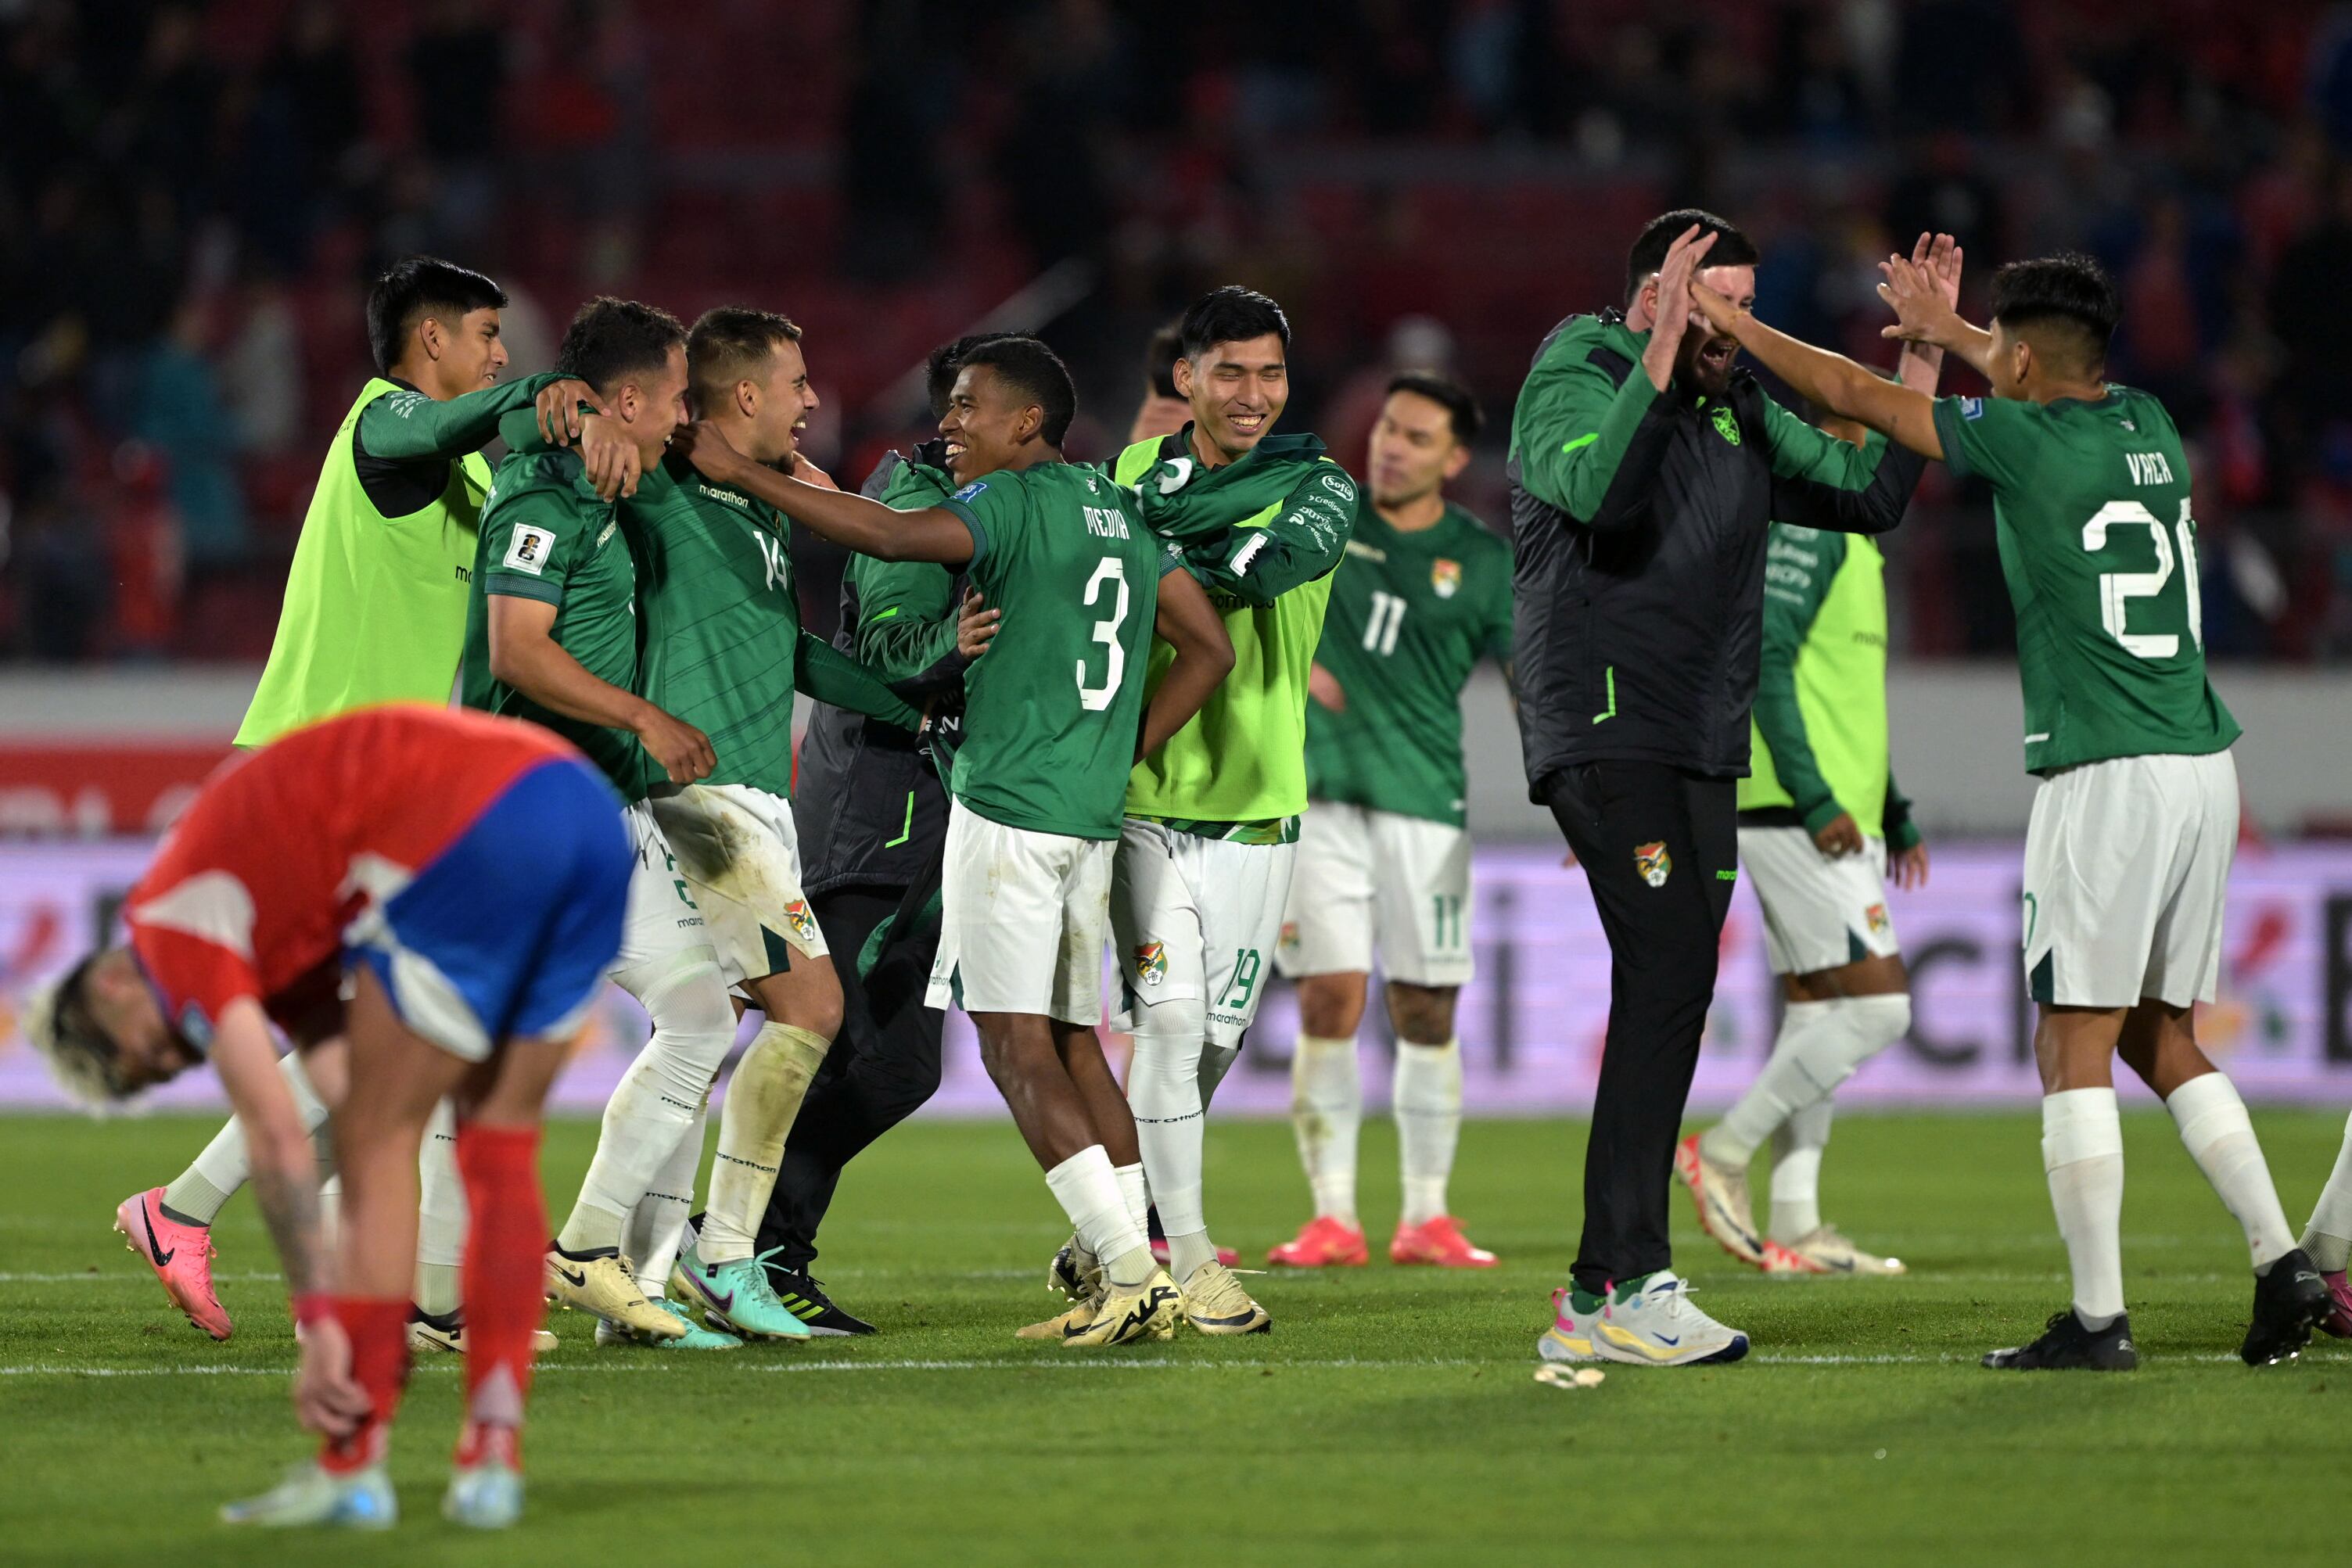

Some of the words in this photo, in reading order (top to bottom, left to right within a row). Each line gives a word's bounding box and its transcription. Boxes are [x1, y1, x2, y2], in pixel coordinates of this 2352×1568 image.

[699, 483, 749, 508] marathon
[2125, 451, 2174, 486] VACA
[752, 530, 788, 592] 14
[1075, 556, 1129, 712] 3
[1361, 590, 1408, 658] 11
[1434, 895, 1462, 949] 11
[1217, 948, 1261, 1010] 19
[1205, 1011, 1247, 1027] marathon
[715, 1151, 777, 1174] arathon
